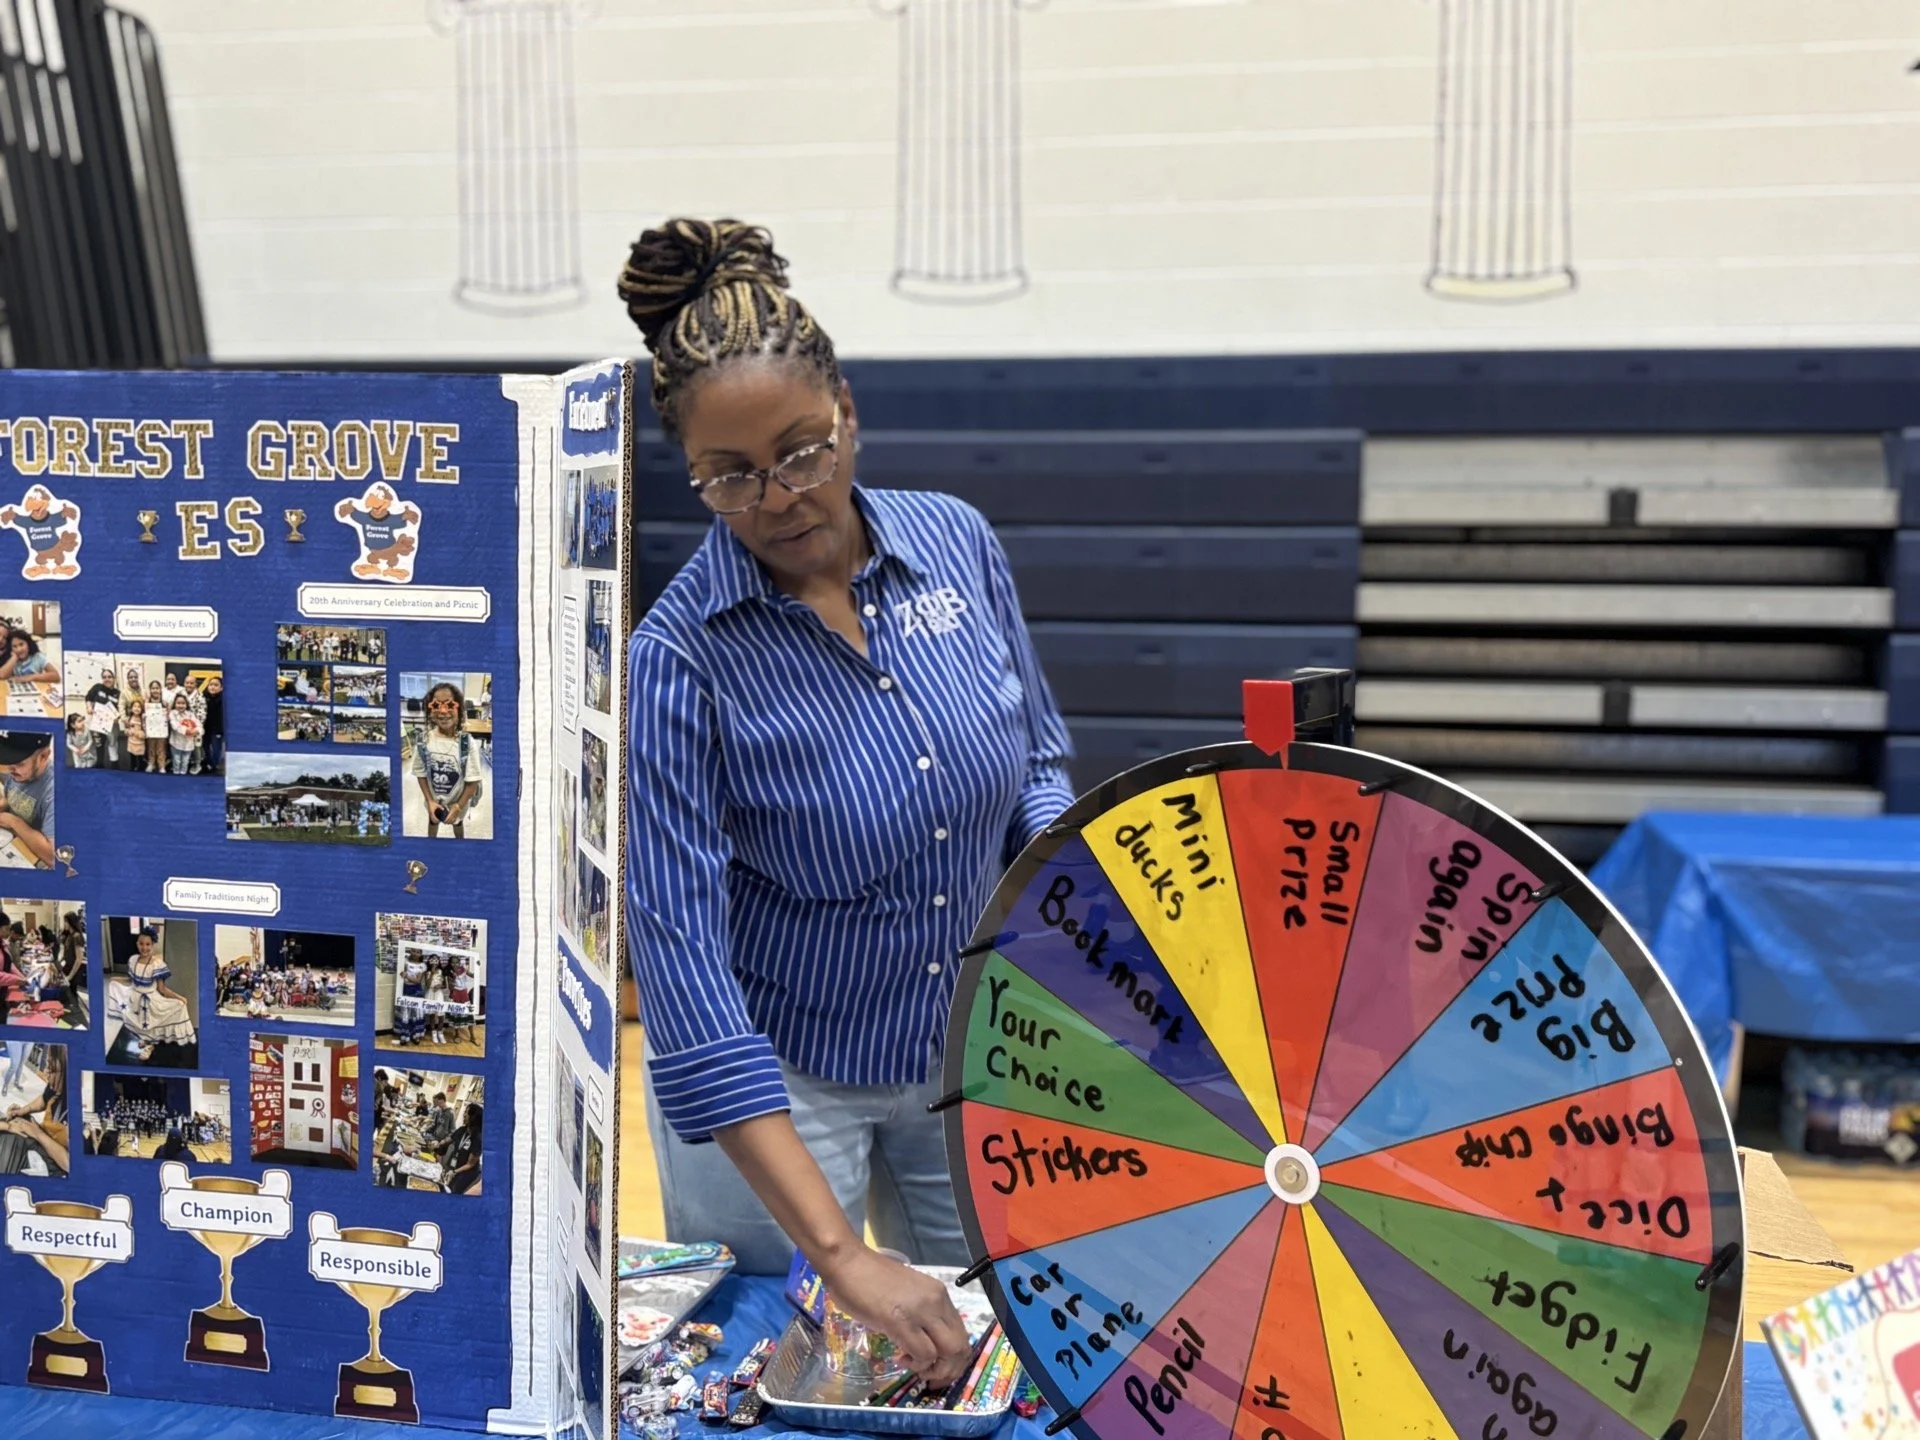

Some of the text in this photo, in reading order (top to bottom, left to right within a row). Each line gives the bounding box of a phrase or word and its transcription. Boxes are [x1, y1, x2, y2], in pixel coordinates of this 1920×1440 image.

[0, 416, 460, 484] OREST GROVE
[176, 496, 265, 560] ES
[125, 619, 206, 629] Family Unity Events
[309, 596, 479, 609] 20th Anniversary Celebration and Picnic
[1115, 819, 1184, 921] ducks
[1162, 793, 1225, 891] Mini
[1321, 821, 1360, 925] Small
[175, 890, 269, 905] Family Traditions Night
[1415, 840, 1483, 953] again
[1462, 872, 1533, 961] Spin
[396, 997, 466, 1013] Falcon Family Night
[989, 976, 1061, 1050] Your
[1470, 954, 1586, 1043] Prize
[1536, 997, 1636, 1061] Big
[986, 1046, 1105, 1112] Choice
[1549, 1102, 1675, 1147] Bingo
[982, 1129, 1148, 1194] Stickers
[21, 1225, 117, 1250] Respectful
[180, 1201, 274, 1226] Champion
[1536, 1177, 1690, 1239] Dice +
[320, 1251, 432, 1280] Responsible
[1051, 1293, 1082, 1330] or
[1056, 1301, 1143, 1380] Plane
[1484, 1271, 1652, 1394] Fidget
[1124, 1317, 1205, 1436] Pencil
[1253, 1375, 1290, 1410] it
[1443, 1328, 1558, 1437] again
